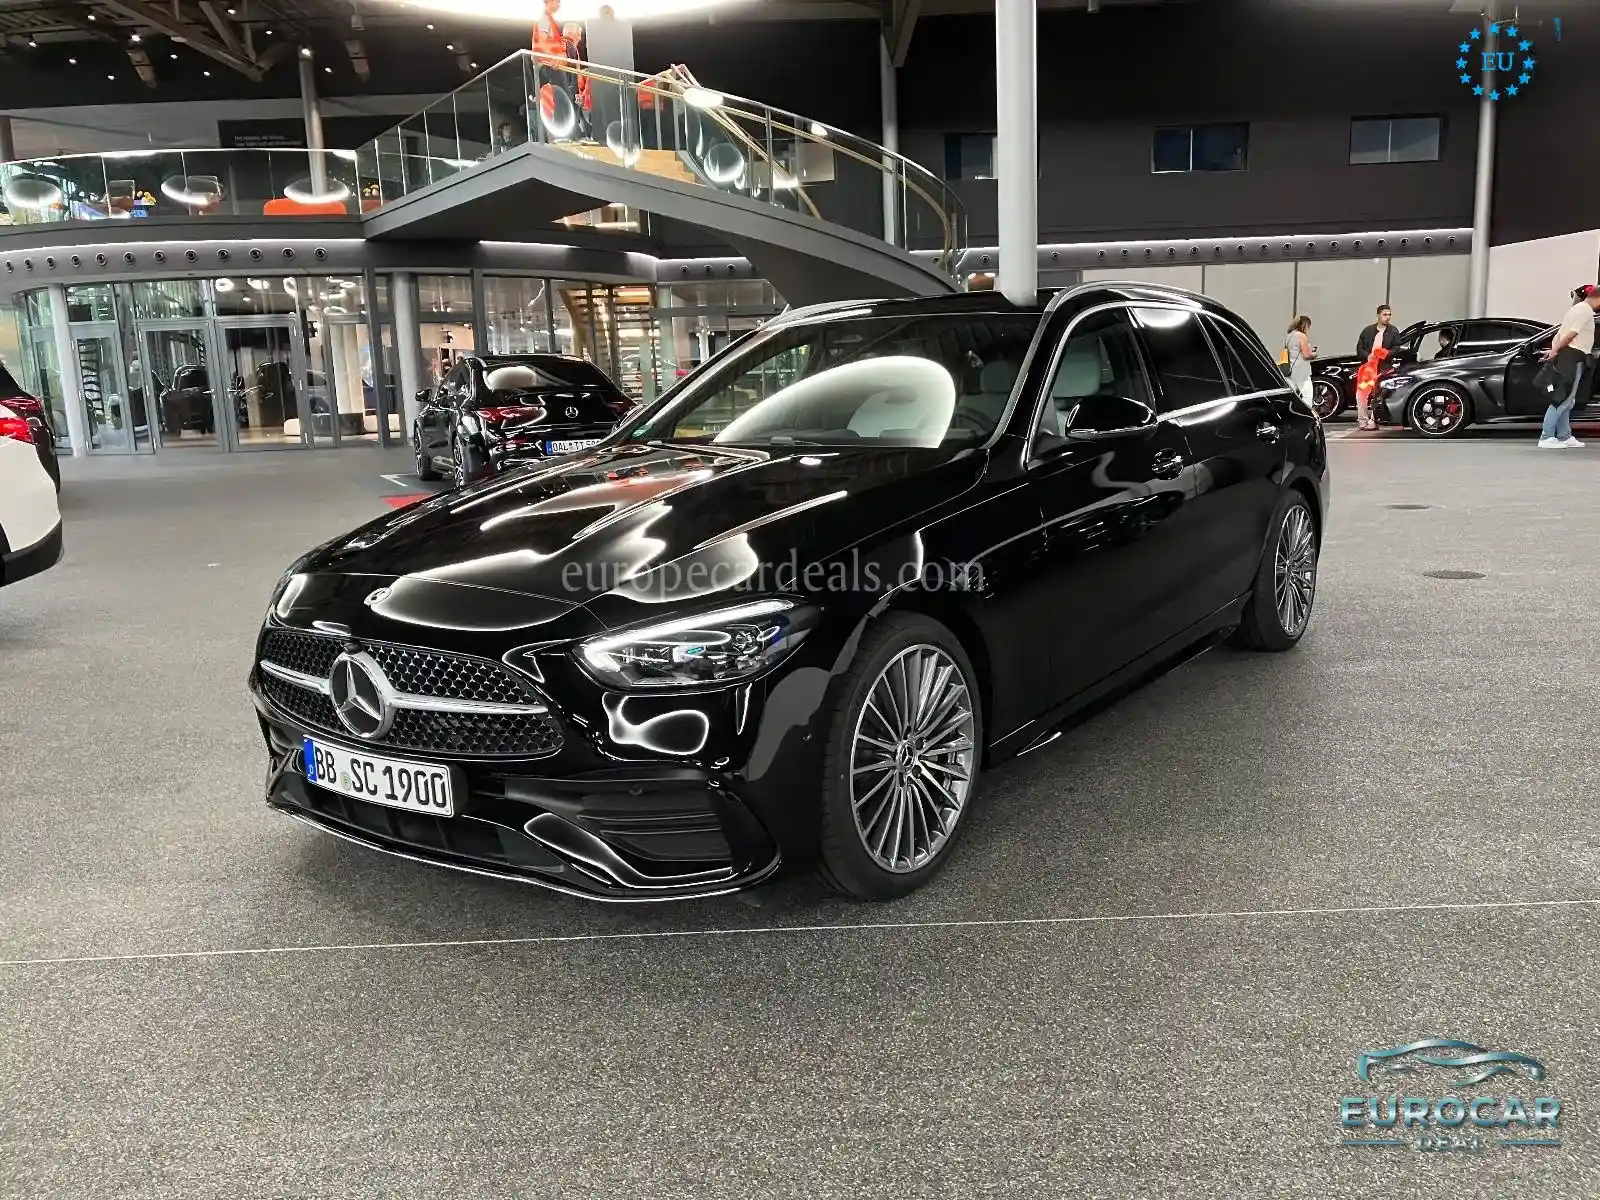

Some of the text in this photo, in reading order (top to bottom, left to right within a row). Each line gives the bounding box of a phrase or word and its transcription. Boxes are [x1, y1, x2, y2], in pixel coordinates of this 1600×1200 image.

[315, 746, 448, 808] BB SC 1900
